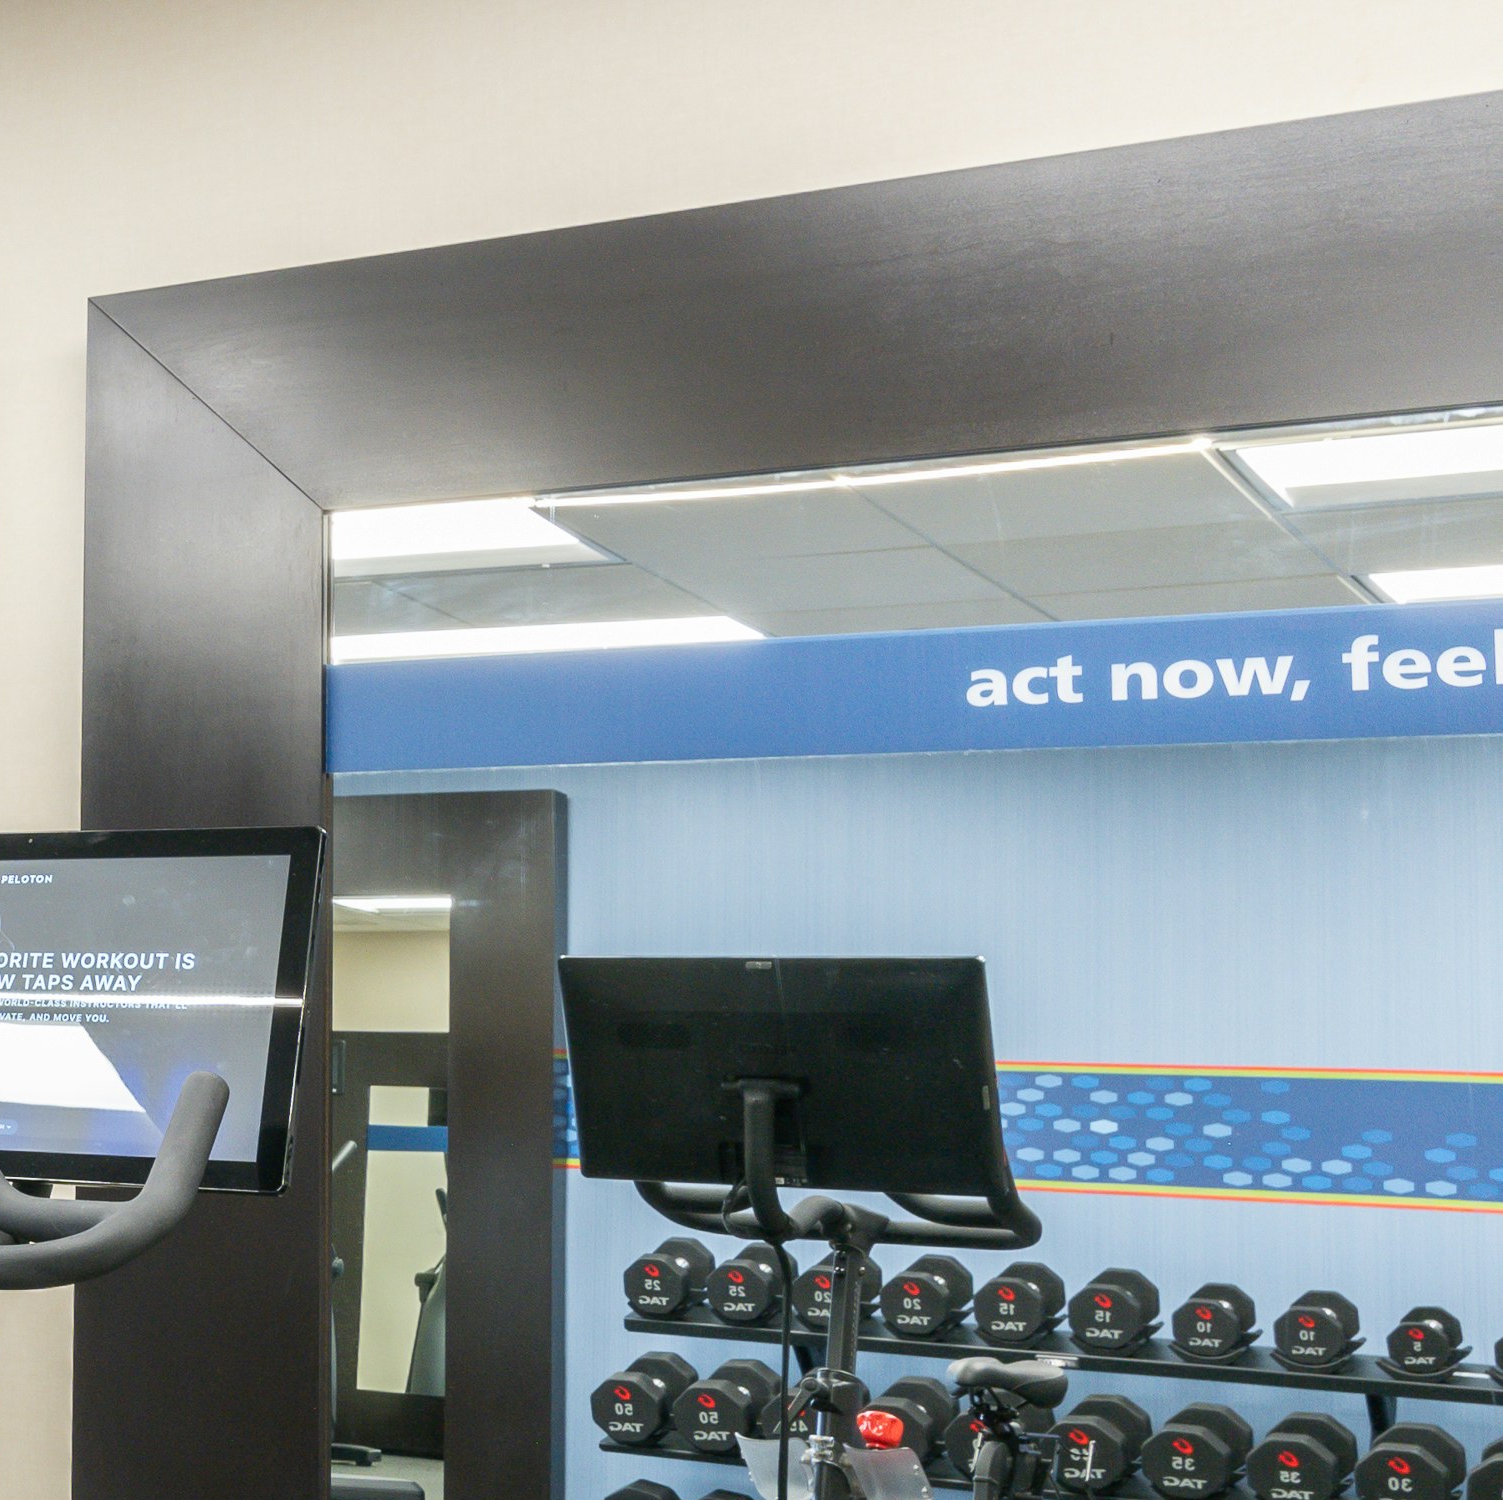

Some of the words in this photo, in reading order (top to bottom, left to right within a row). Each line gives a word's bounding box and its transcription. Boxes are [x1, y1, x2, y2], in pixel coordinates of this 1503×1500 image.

[966, 654, 1084, 707] act
[1111, 655, 1311, 702] now,
[1, 874, 53, 884] PELOTON
[61, 952, 169, 969] WORKOUT
[175, 953, 196, 969] IS
[22, 974, 74, 990] TAPS
[79, 975, 143, 991] AWAY
[29, 1013, 50, 1022] AND
[52, 1013, 82, 1022] MOVE
[85, 1014, 110, 1023] YOU.
